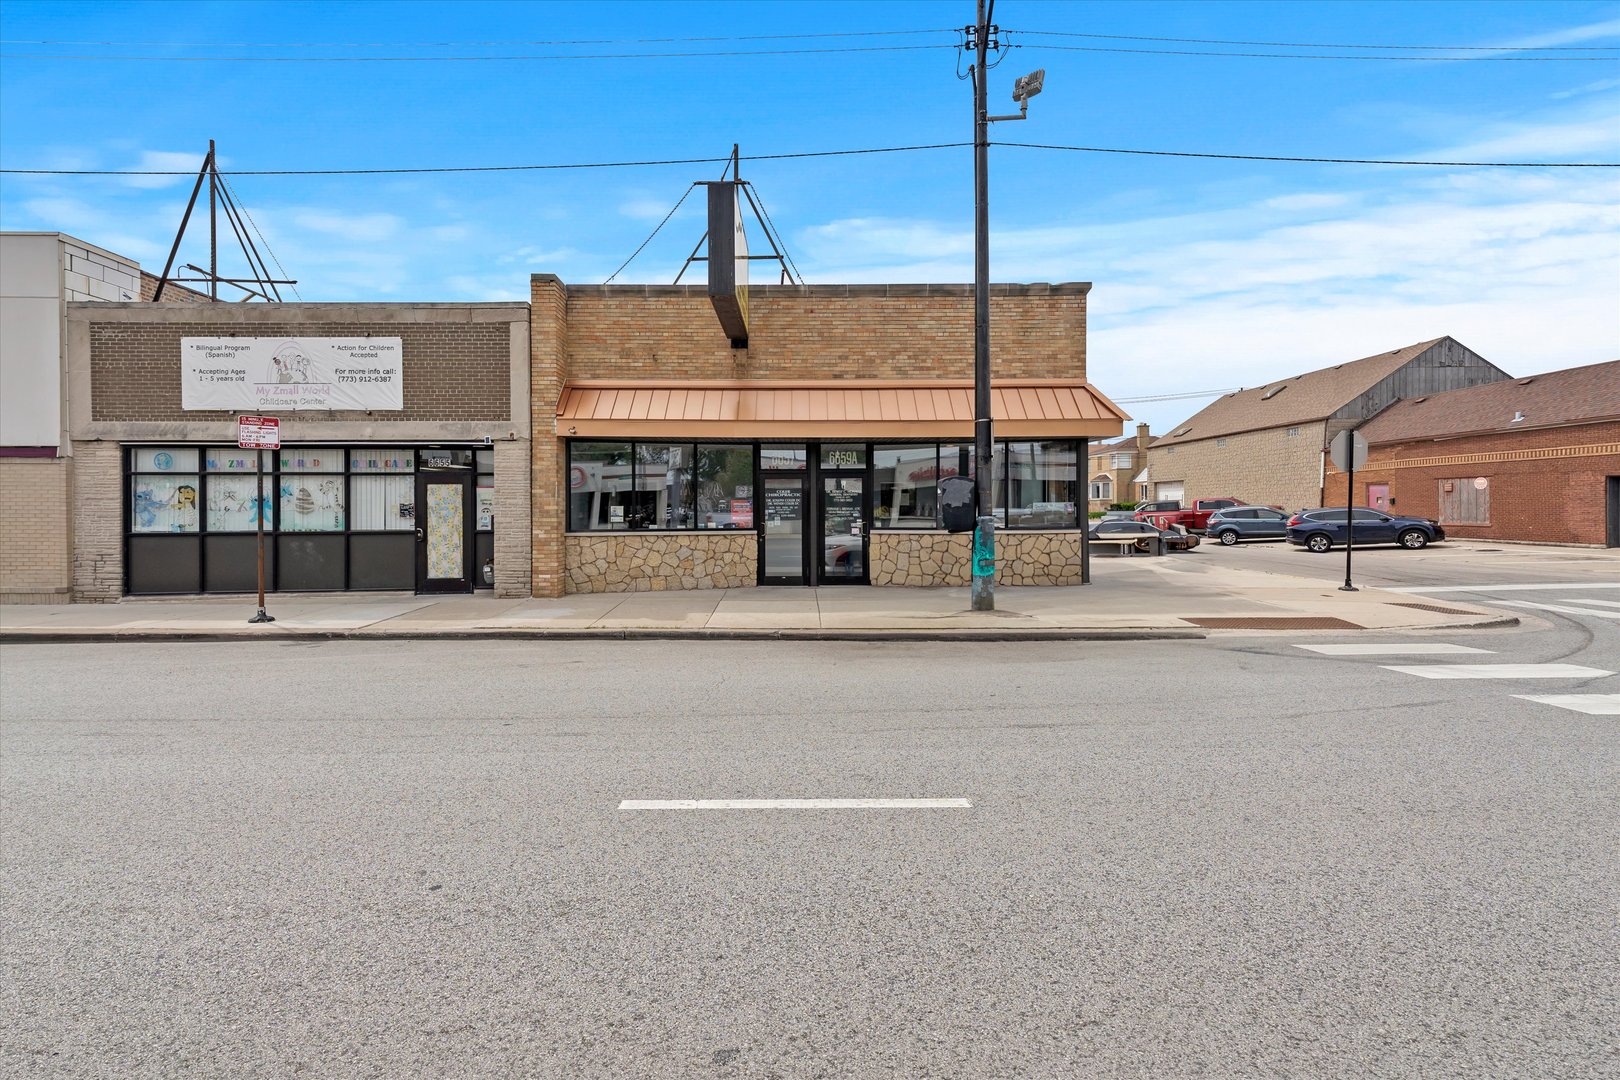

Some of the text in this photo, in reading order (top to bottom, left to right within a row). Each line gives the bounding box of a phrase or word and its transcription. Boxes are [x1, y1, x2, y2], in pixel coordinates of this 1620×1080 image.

[256, 386, 330, 397] My Zmall World
[259, 397, 326, 405] Childcare Center
[829, 451, 858, 464] 6659A
